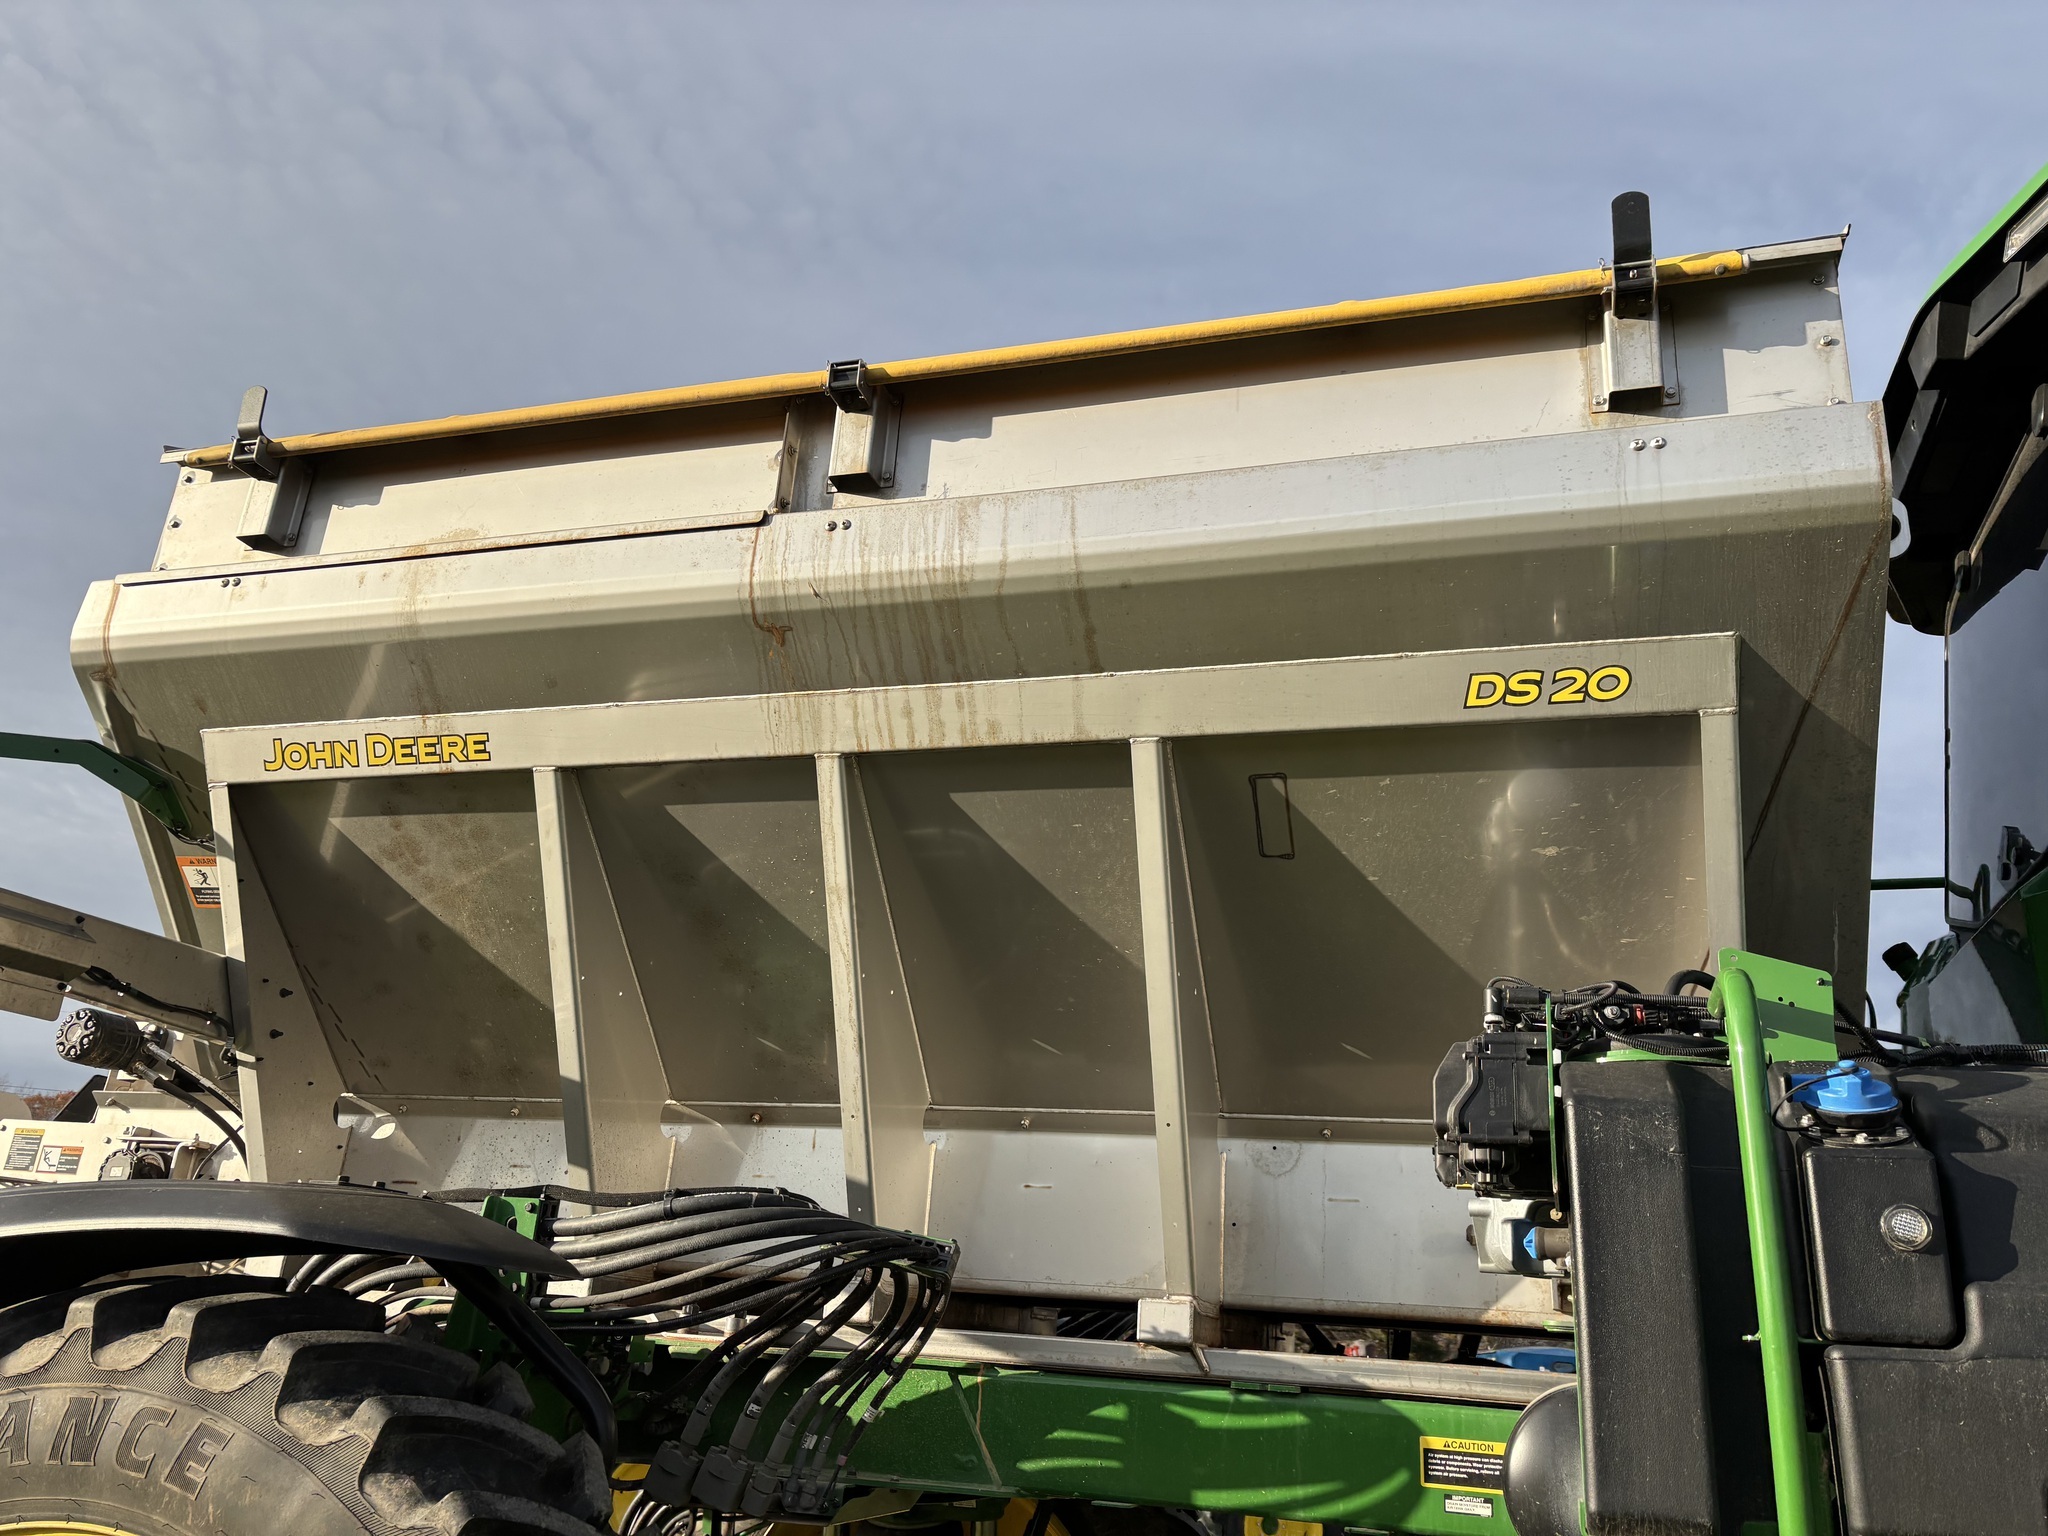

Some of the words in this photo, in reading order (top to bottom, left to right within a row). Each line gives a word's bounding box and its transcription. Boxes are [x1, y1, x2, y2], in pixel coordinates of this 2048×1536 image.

[1463, 670, 1544, 709] DS
[1548, 665, 1632, 705] 20
[264, 738, 359, 771] JOHN
[365, 732, 491, 767] DEERE
[0, 1395, 235, 1500] ANCE
[1450, 1440, 1494, 1452] CAUTION
[1452, 1495, 1484, 1503] IMPORTANT
